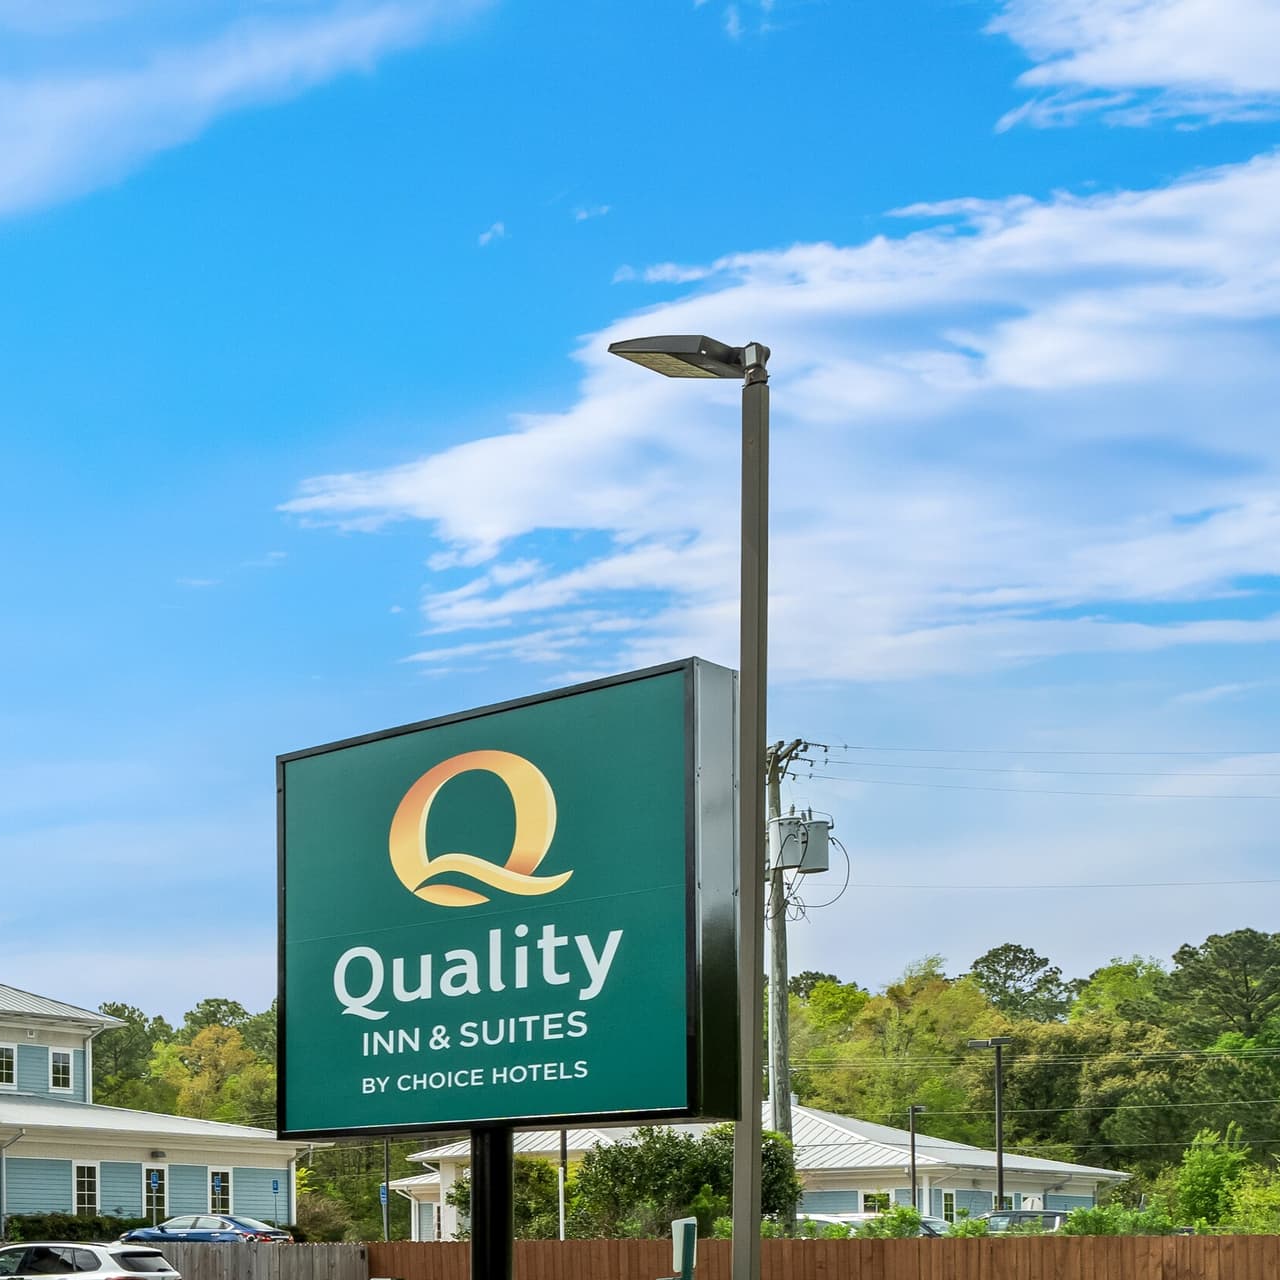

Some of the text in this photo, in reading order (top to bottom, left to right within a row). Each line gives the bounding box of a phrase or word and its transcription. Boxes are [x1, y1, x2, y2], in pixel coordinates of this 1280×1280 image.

[388, 749, 574, 907] Q
[333, 924, 624, 1021] Quality
[362, 1010, 588, 1057] INN & SUITES
[362, 1060, 589, 1094] BY CHOICE HOTELS
